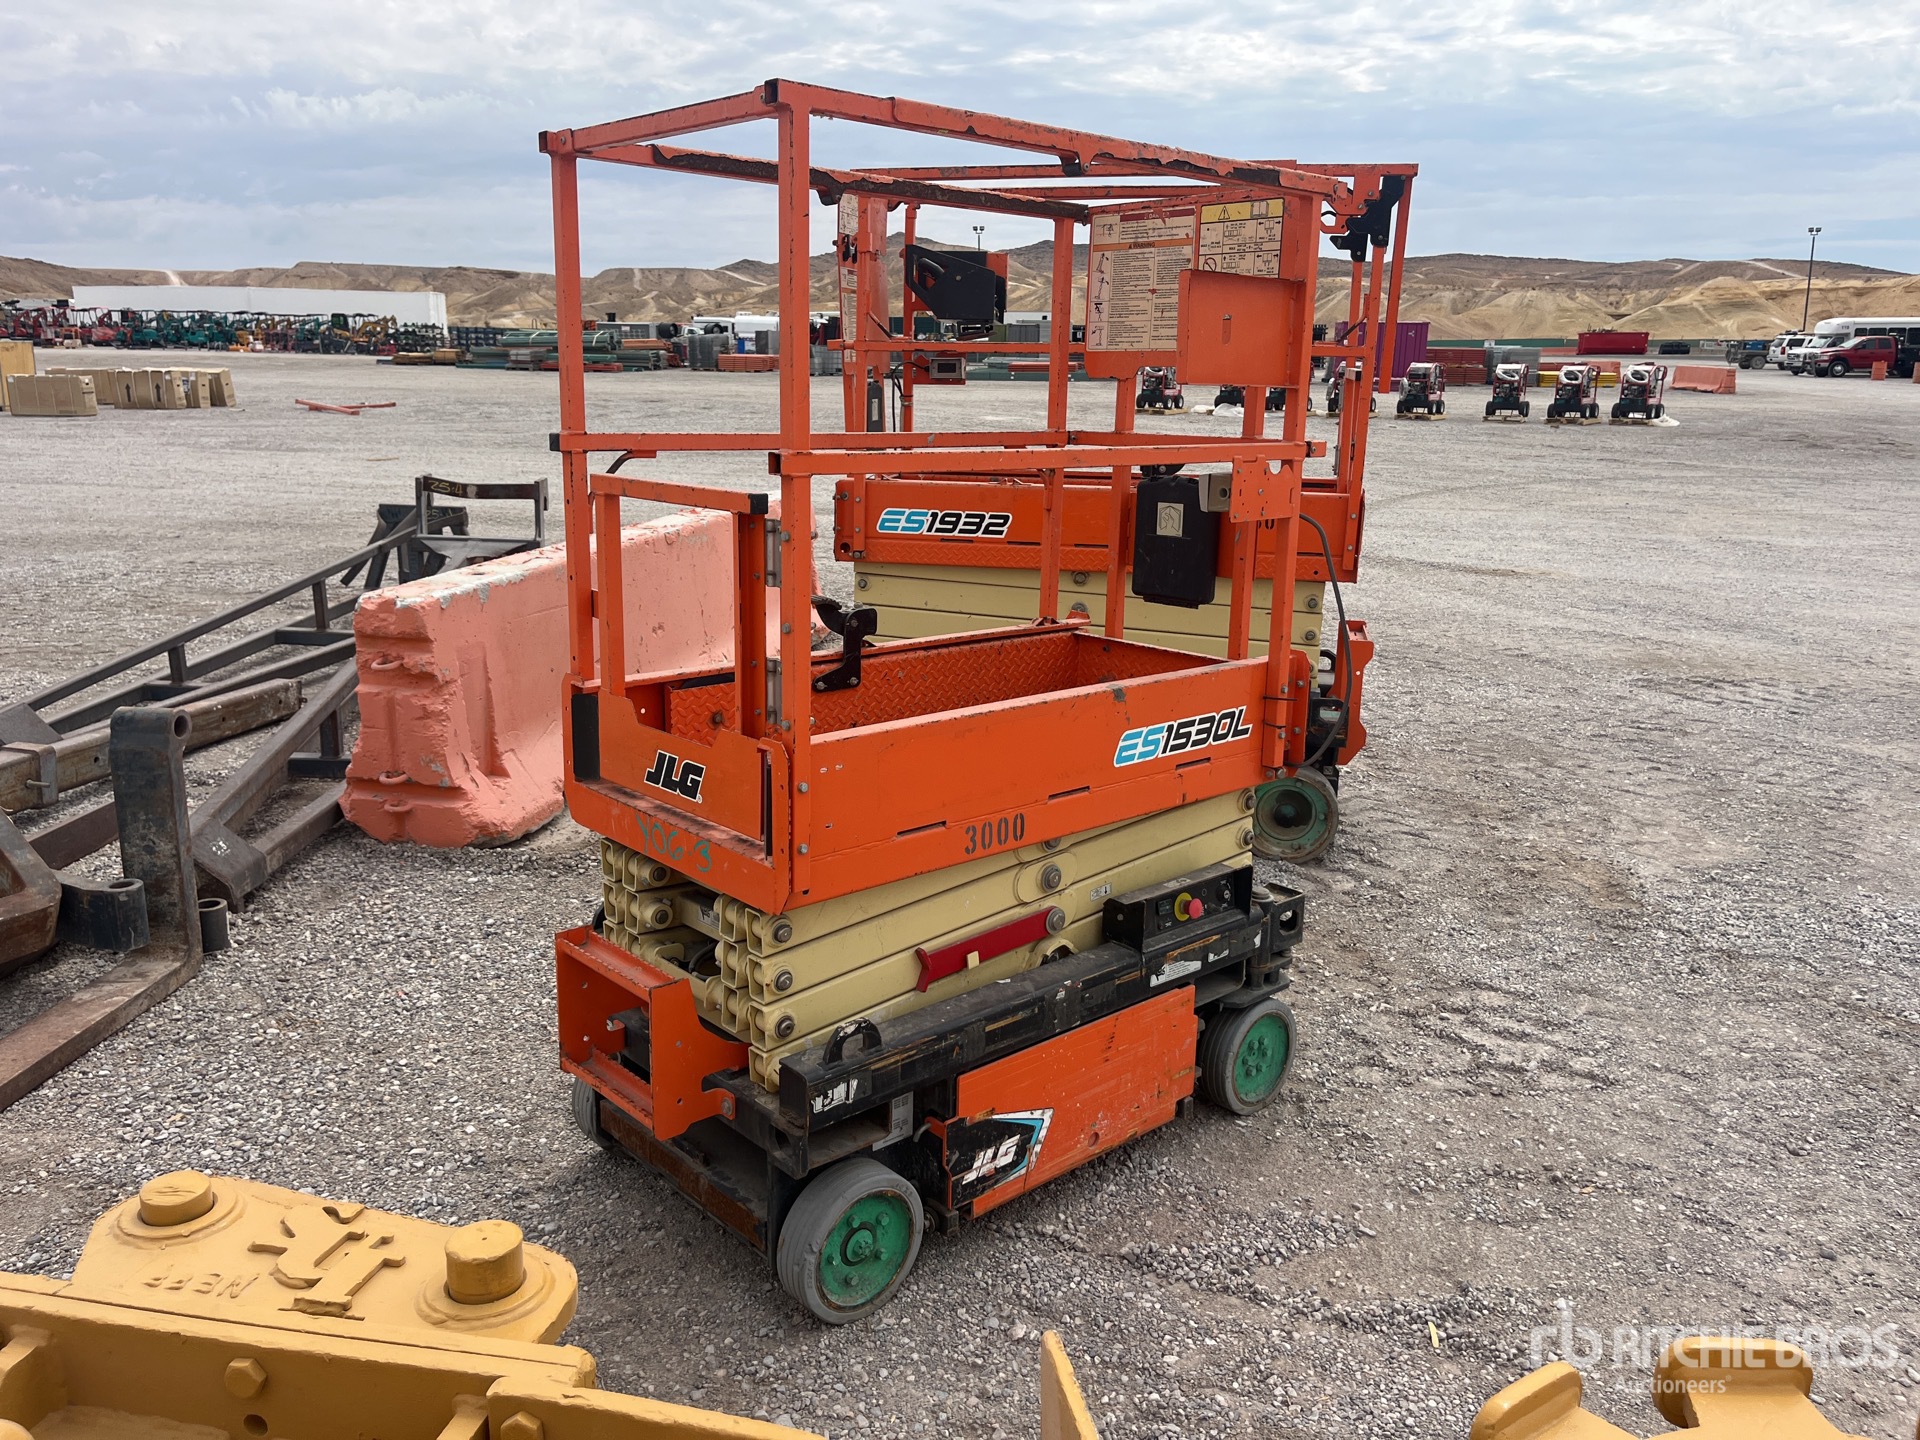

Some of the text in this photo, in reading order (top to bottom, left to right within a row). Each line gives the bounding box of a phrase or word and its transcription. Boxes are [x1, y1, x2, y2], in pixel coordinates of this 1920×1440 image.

[877, 508, 1012, 538] ES1932
[1113, 705, 1253, 767] ES1530L
[644, 750, 706, 802] JLG
[964, 812, 1025, 855] 3000
[962, 1133, 1021, 1185] JLG
